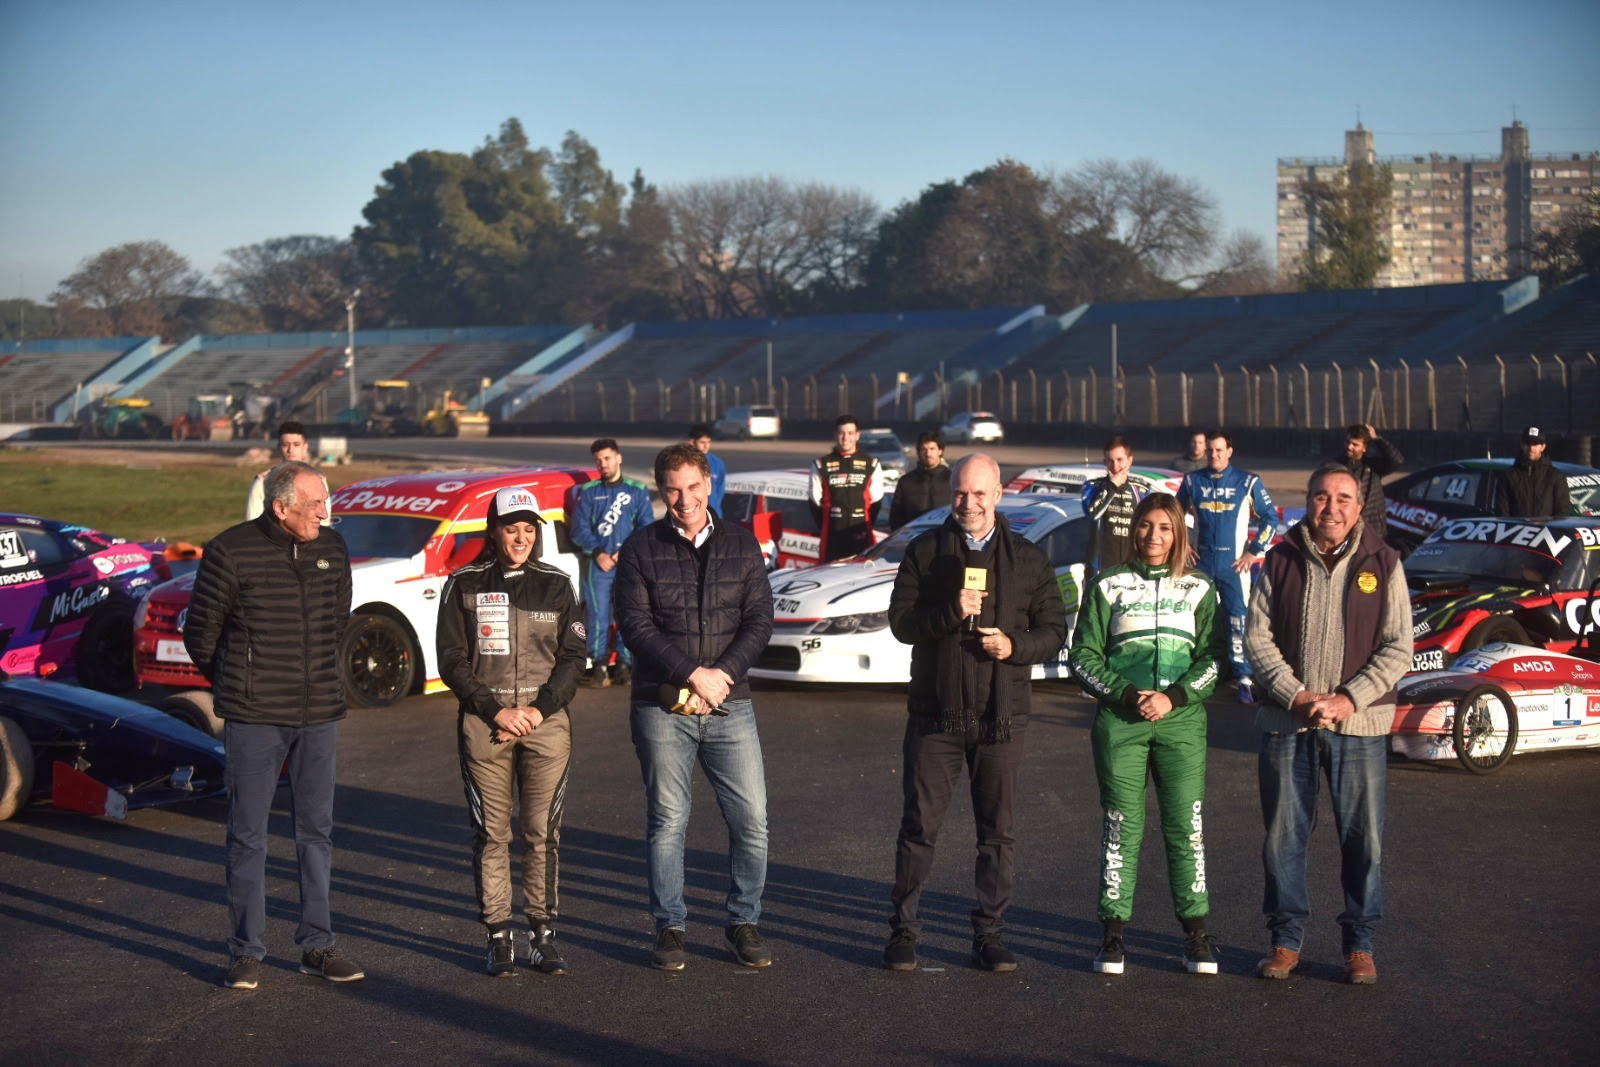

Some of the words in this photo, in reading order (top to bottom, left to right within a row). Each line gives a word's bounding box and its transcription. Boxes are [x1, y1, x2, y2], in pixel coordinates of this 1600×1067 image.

[1200, 486, 1236, 499] YPF
[1445, 478, 1467, 497] 44
[330, 491, 448, 513] V-Power
[508, 494, 532, 505] AMA
[1423, 519, 1571, 558] CORVEN
[0, 570, 44, 586] TROFUEL
[480, 594, 506, 603] AMA
[776, 598, 801, 614] AUTO
[534, 612, 556, 620] FAITH
[1412, 621, 1432, 635] etti
[801, 637, 822, 651] 56
[1408, 660, 1444, 672] LIONE
[1513, 661, 1543, 673] AMD
[1519, 704, 1548, 713] motorola
[1565, 697, 1571, 719] 1
